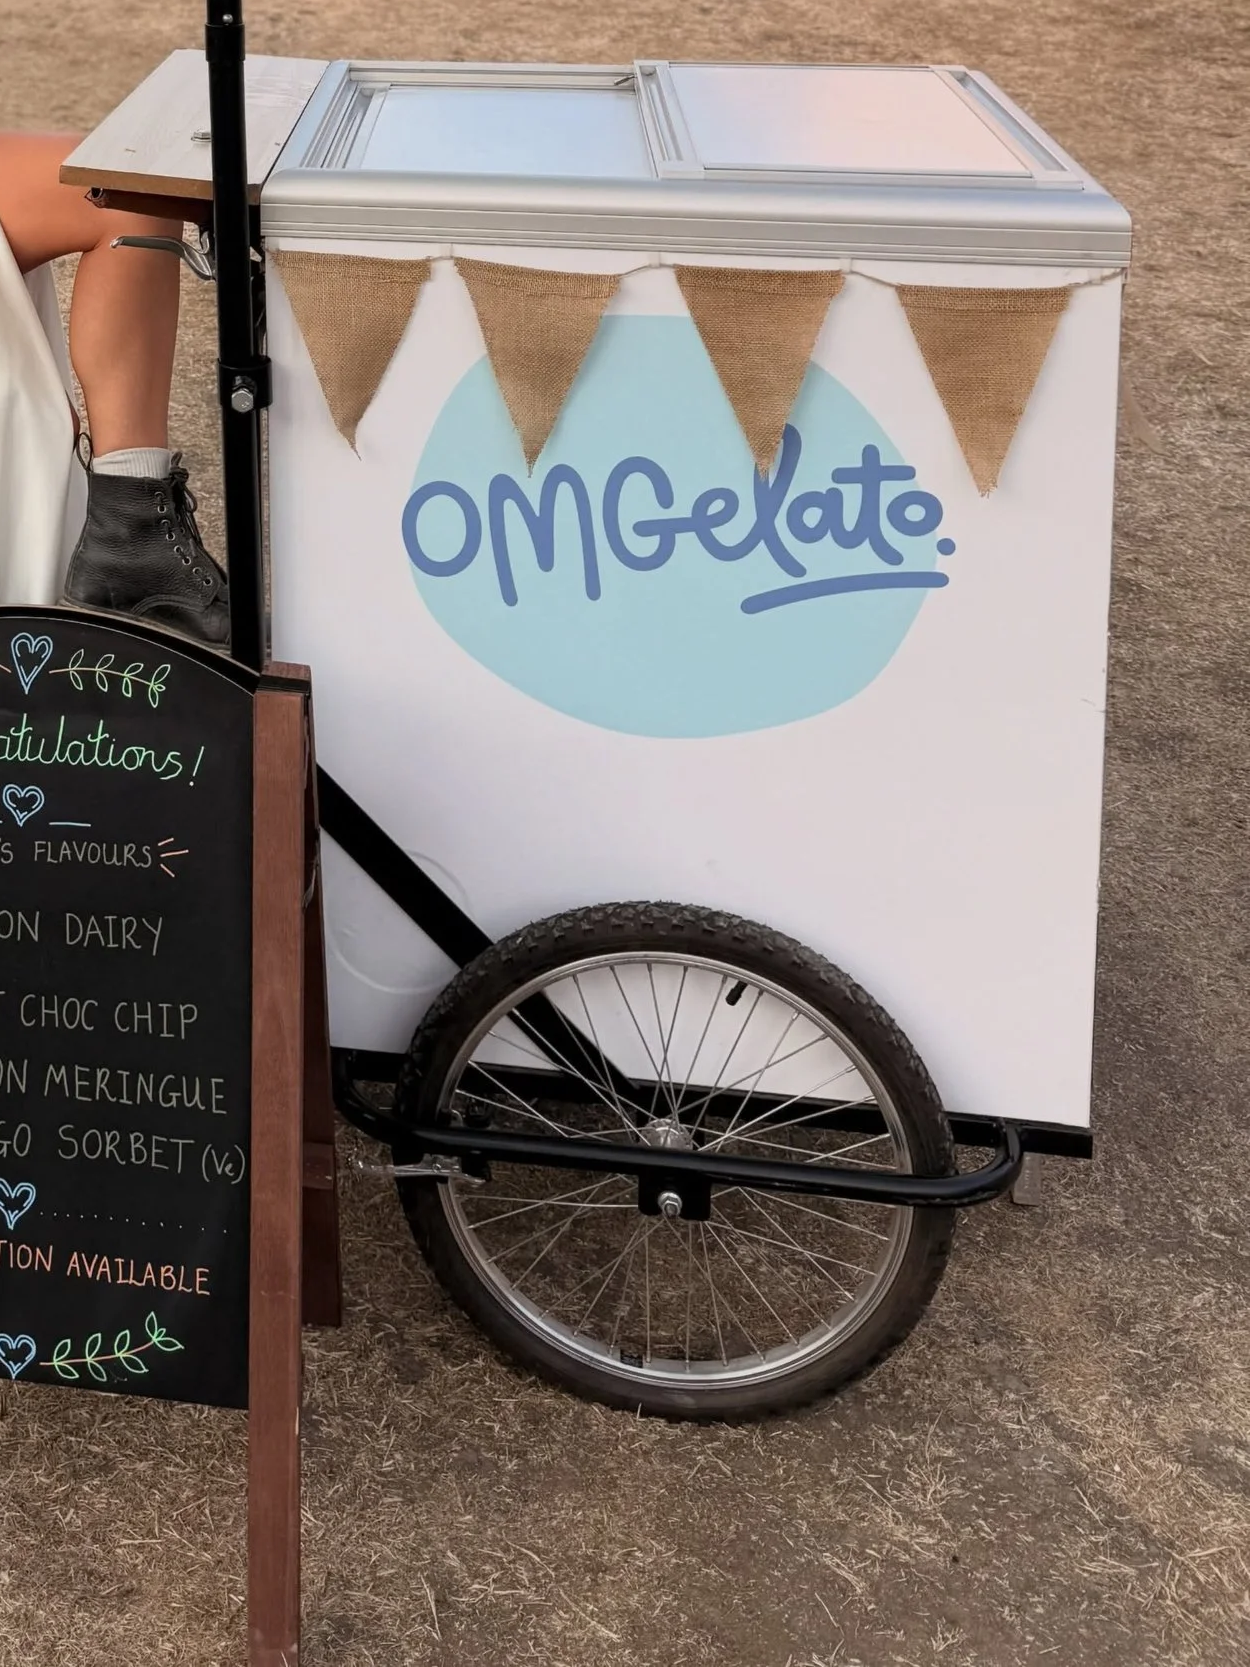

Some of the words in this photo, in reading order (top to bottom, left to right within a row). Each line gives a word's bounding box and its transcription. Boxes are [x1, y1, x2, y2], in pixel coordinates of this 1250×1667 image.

[33, 838, 153, 869] FLAVOURS
[65, 912, 163, 956] DAIRY
[20, 994, 98, 1031] CHOC
[114, 1001, 198, 1039] CHIP
[44, 1064, 227, 1114] MERINGUE
[58, 1124, 194, 1173] SORBET
[66, 1250, 211, 1295] AVAILABLE
